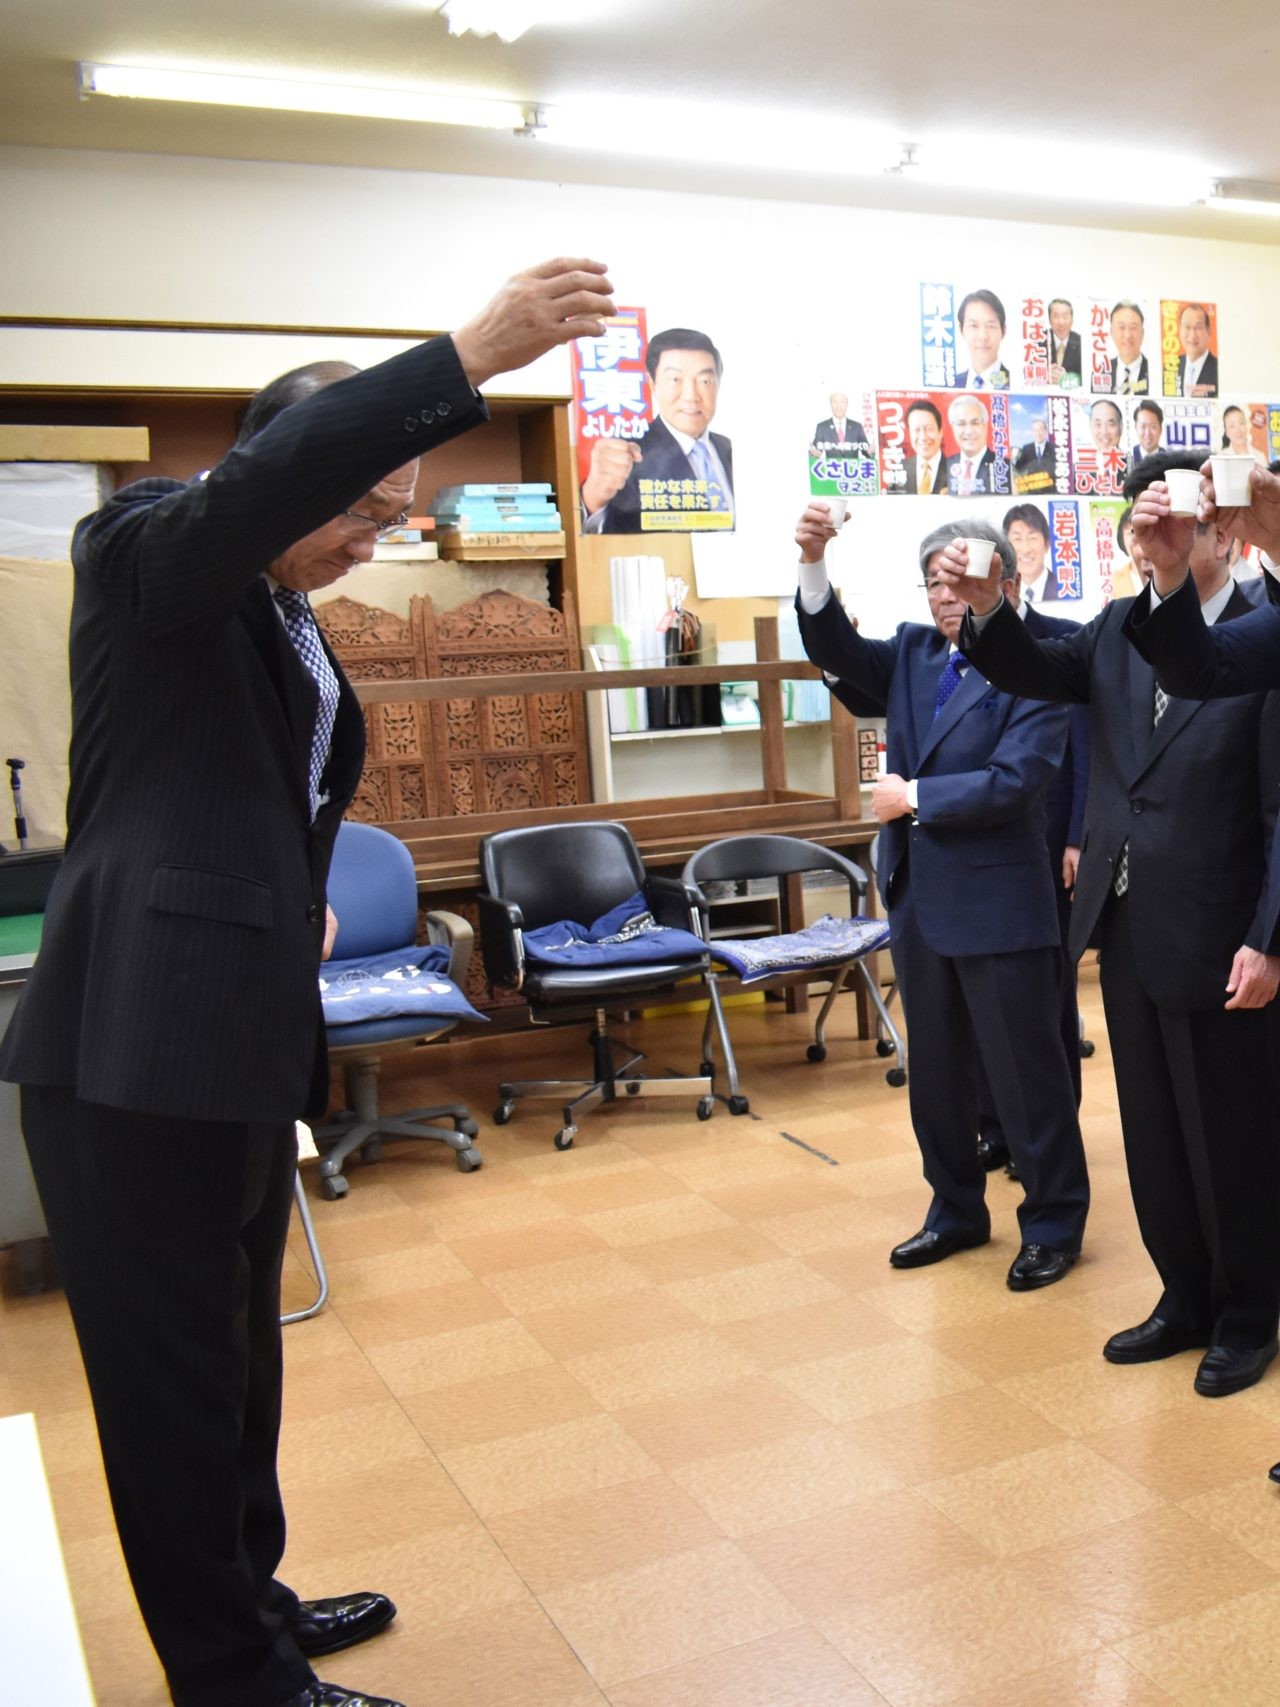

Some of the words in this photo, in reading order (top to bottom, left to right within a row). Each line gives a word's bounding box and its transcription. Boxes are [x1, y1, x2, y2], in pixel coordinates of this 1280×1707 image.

[1022, 298, 1048, 364] おばた
[1091, 304, 1111, 374] かさい
[575, 326, 648, 414] 伊東
[582, 414, 650, 439] よしたか
[880, 402, 905, 470] つづき
[1166, 421, 1211, 446] 山口
[813, 461, 876, 479] くさじま
[1076, 448, 1126, 473] 三木
[638, 479, 721, 495] 確かな未来へ
[1075, 473, 1125, 494] ひとし
